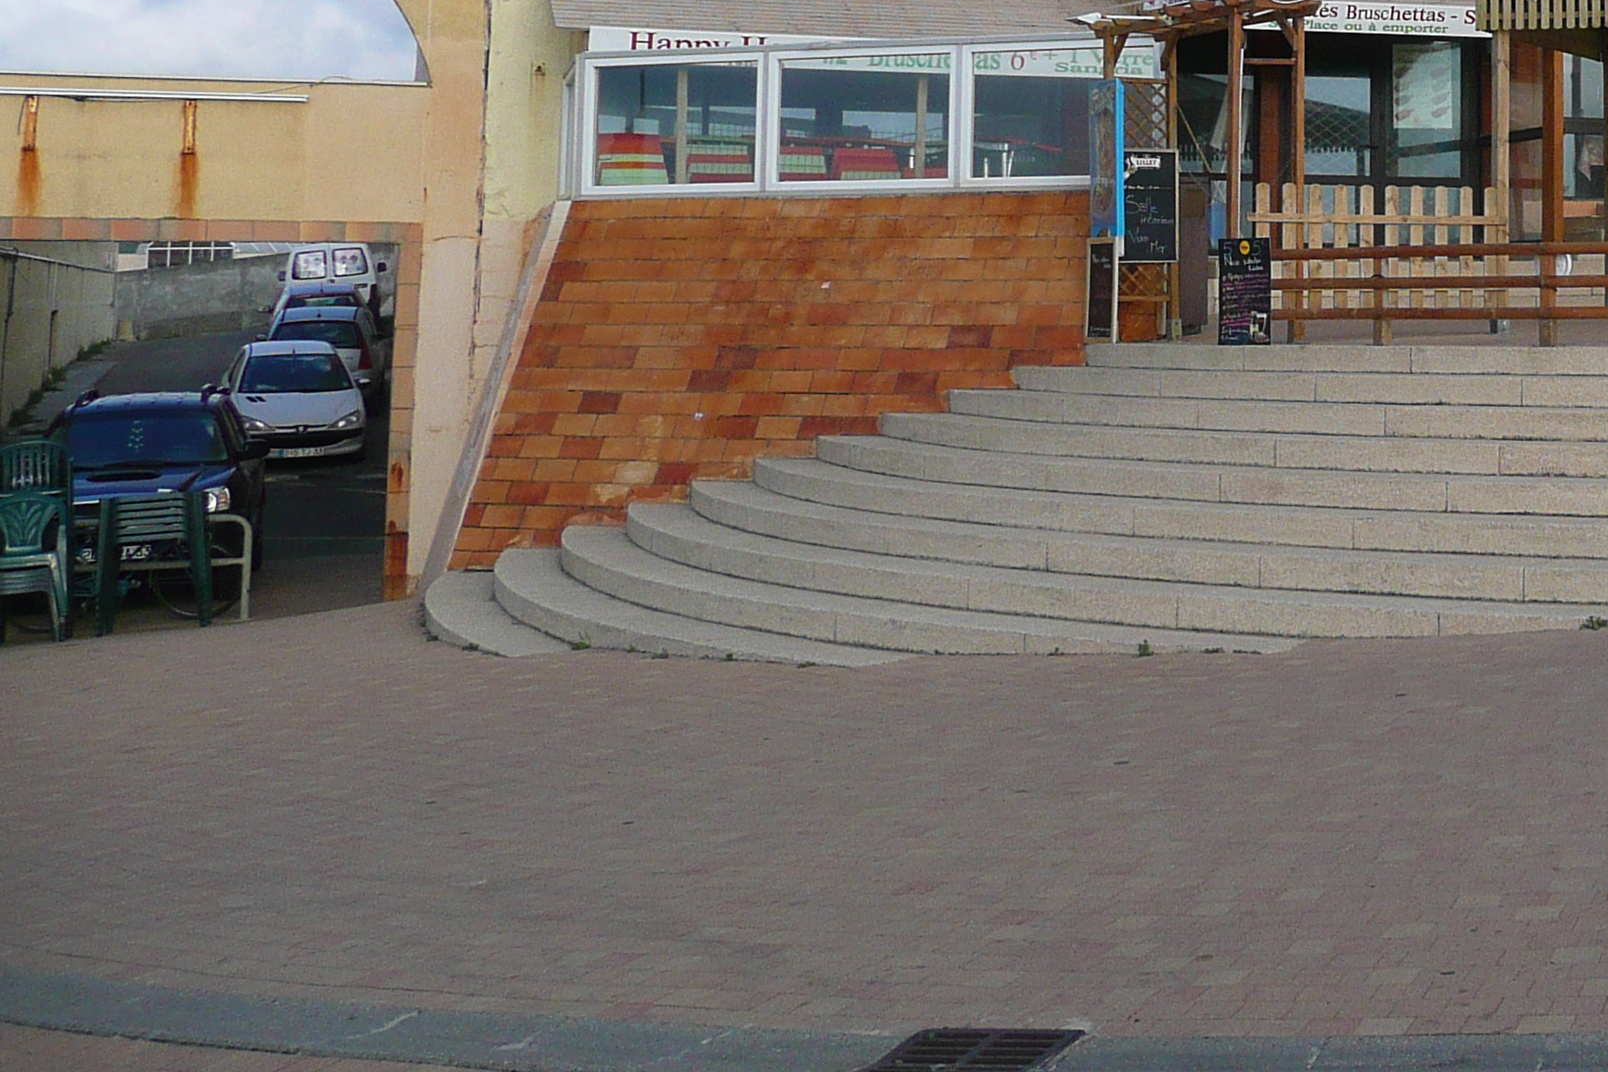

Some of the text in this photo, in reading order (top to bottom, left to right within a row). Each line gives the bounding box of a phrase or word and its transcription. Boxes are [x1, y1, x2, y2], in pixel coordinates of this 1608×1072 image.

[1346, 4, 1446, 23] Bruschettas
[1344, 23, 1362, 32] ou
[1368, 22, 1377, 31] à
[1382, 24, 1449, 34] emporter
[1090, 49, 1155, 67] Vrre
